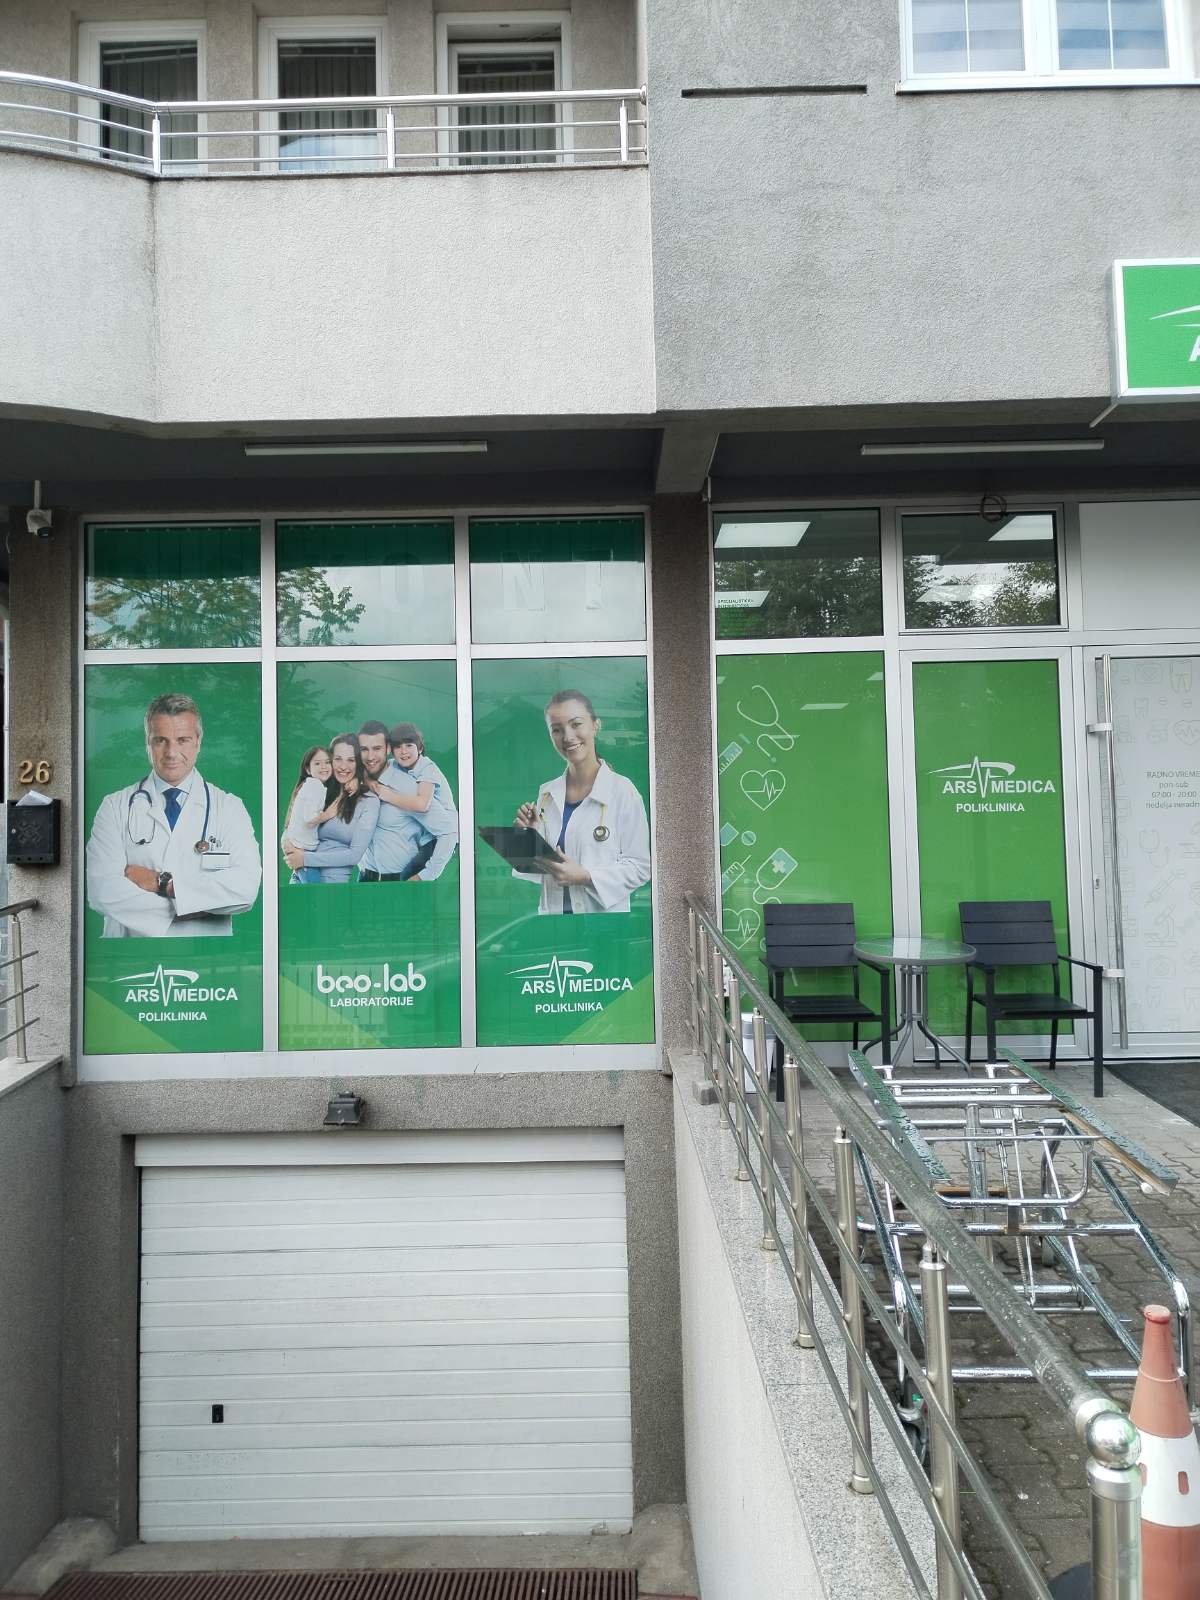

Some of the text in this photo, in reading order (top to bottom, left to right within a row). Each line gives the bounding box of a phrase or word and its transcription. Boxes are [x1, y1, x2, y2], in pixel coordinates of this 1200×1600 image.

[20, 760, 50, 784] 26
[942, 780, 1056, 794] ARS MEDICA
[956, 803, 1025, 813] POLIKLINIKA
[521, 977, 634, 995] ARS MEDICA
[125, 988, 238, 1003] ARS MEDICA
[330, 997, 414, 1007] LABORATORIJE
[535, 1002, 604, 1013] POLIKLINIKA
[138, 1011, 208, 1022] POLIKLINIKA
